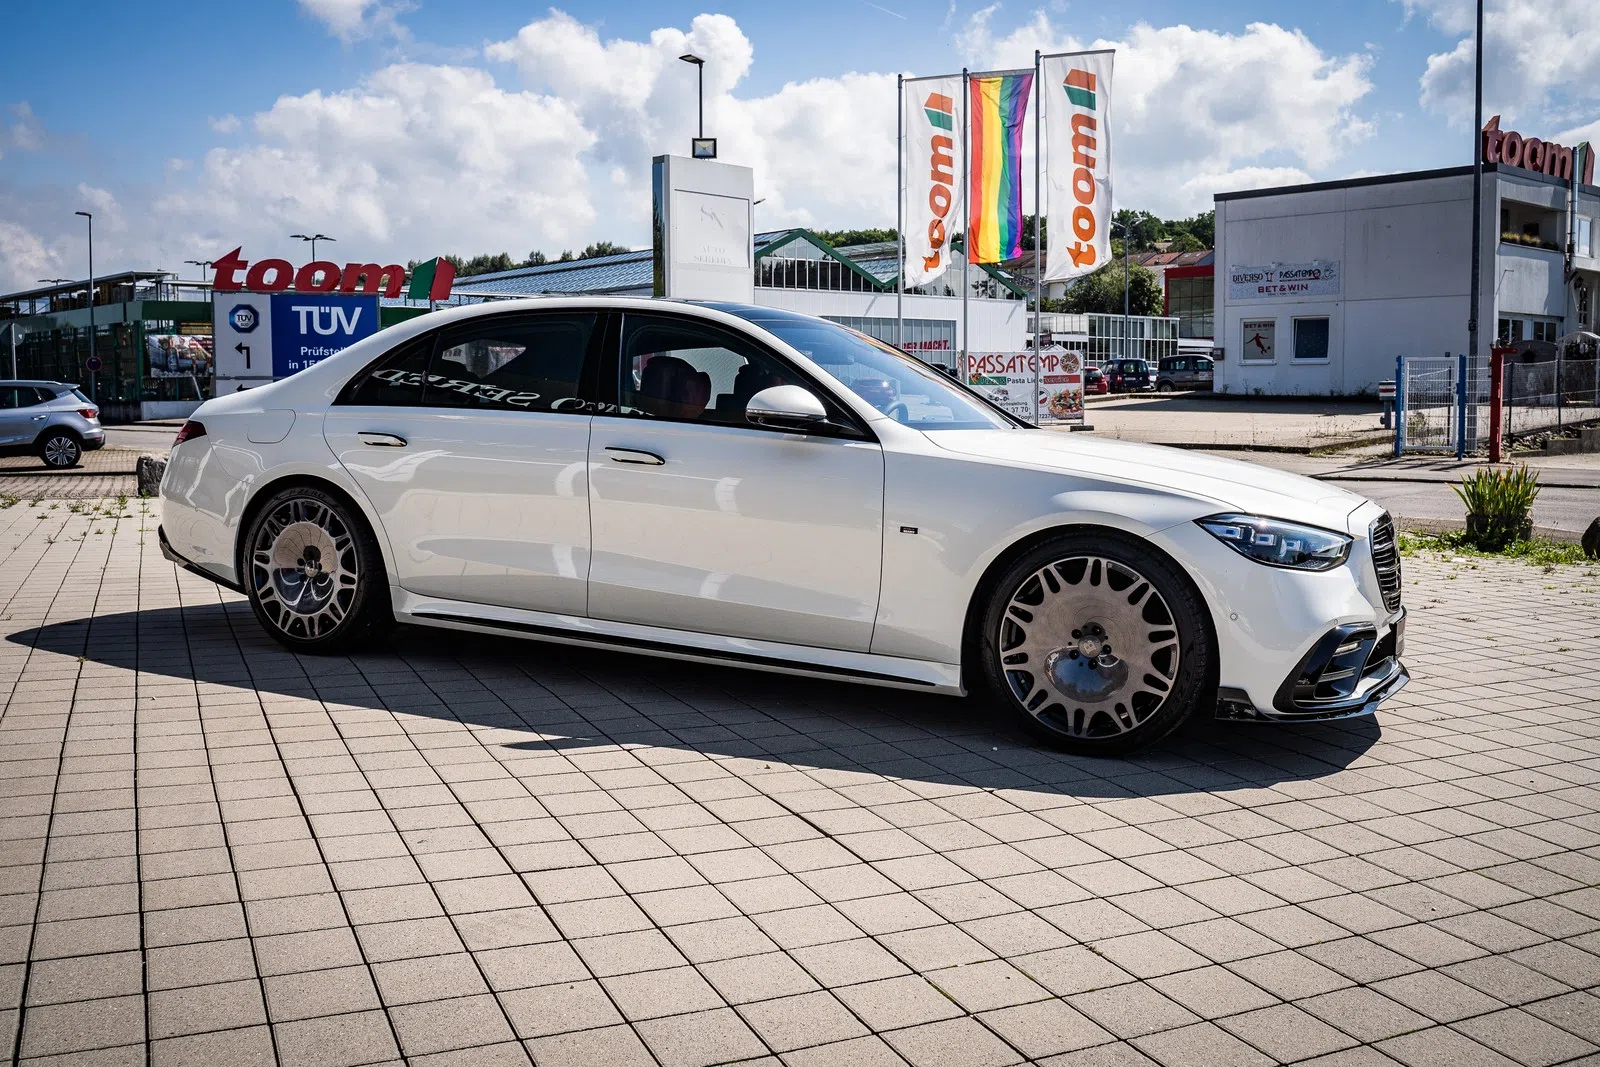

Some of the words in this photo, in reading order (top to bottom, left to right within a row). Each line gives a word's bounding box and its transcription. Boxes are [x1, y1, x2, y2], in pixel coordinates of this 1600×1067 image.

[1482, 115, 1573, 181] toom
[922, 134, 954, 272] toom
[1066, 112, 1097, 268] toom
[211, 245, 405, 299] toom
[291, 305, 362, 336] TÜV
[288, 360, 299, 369] in
[302, 360, 321, 369] 15
[300, 346, 346, 356] Prüfste
